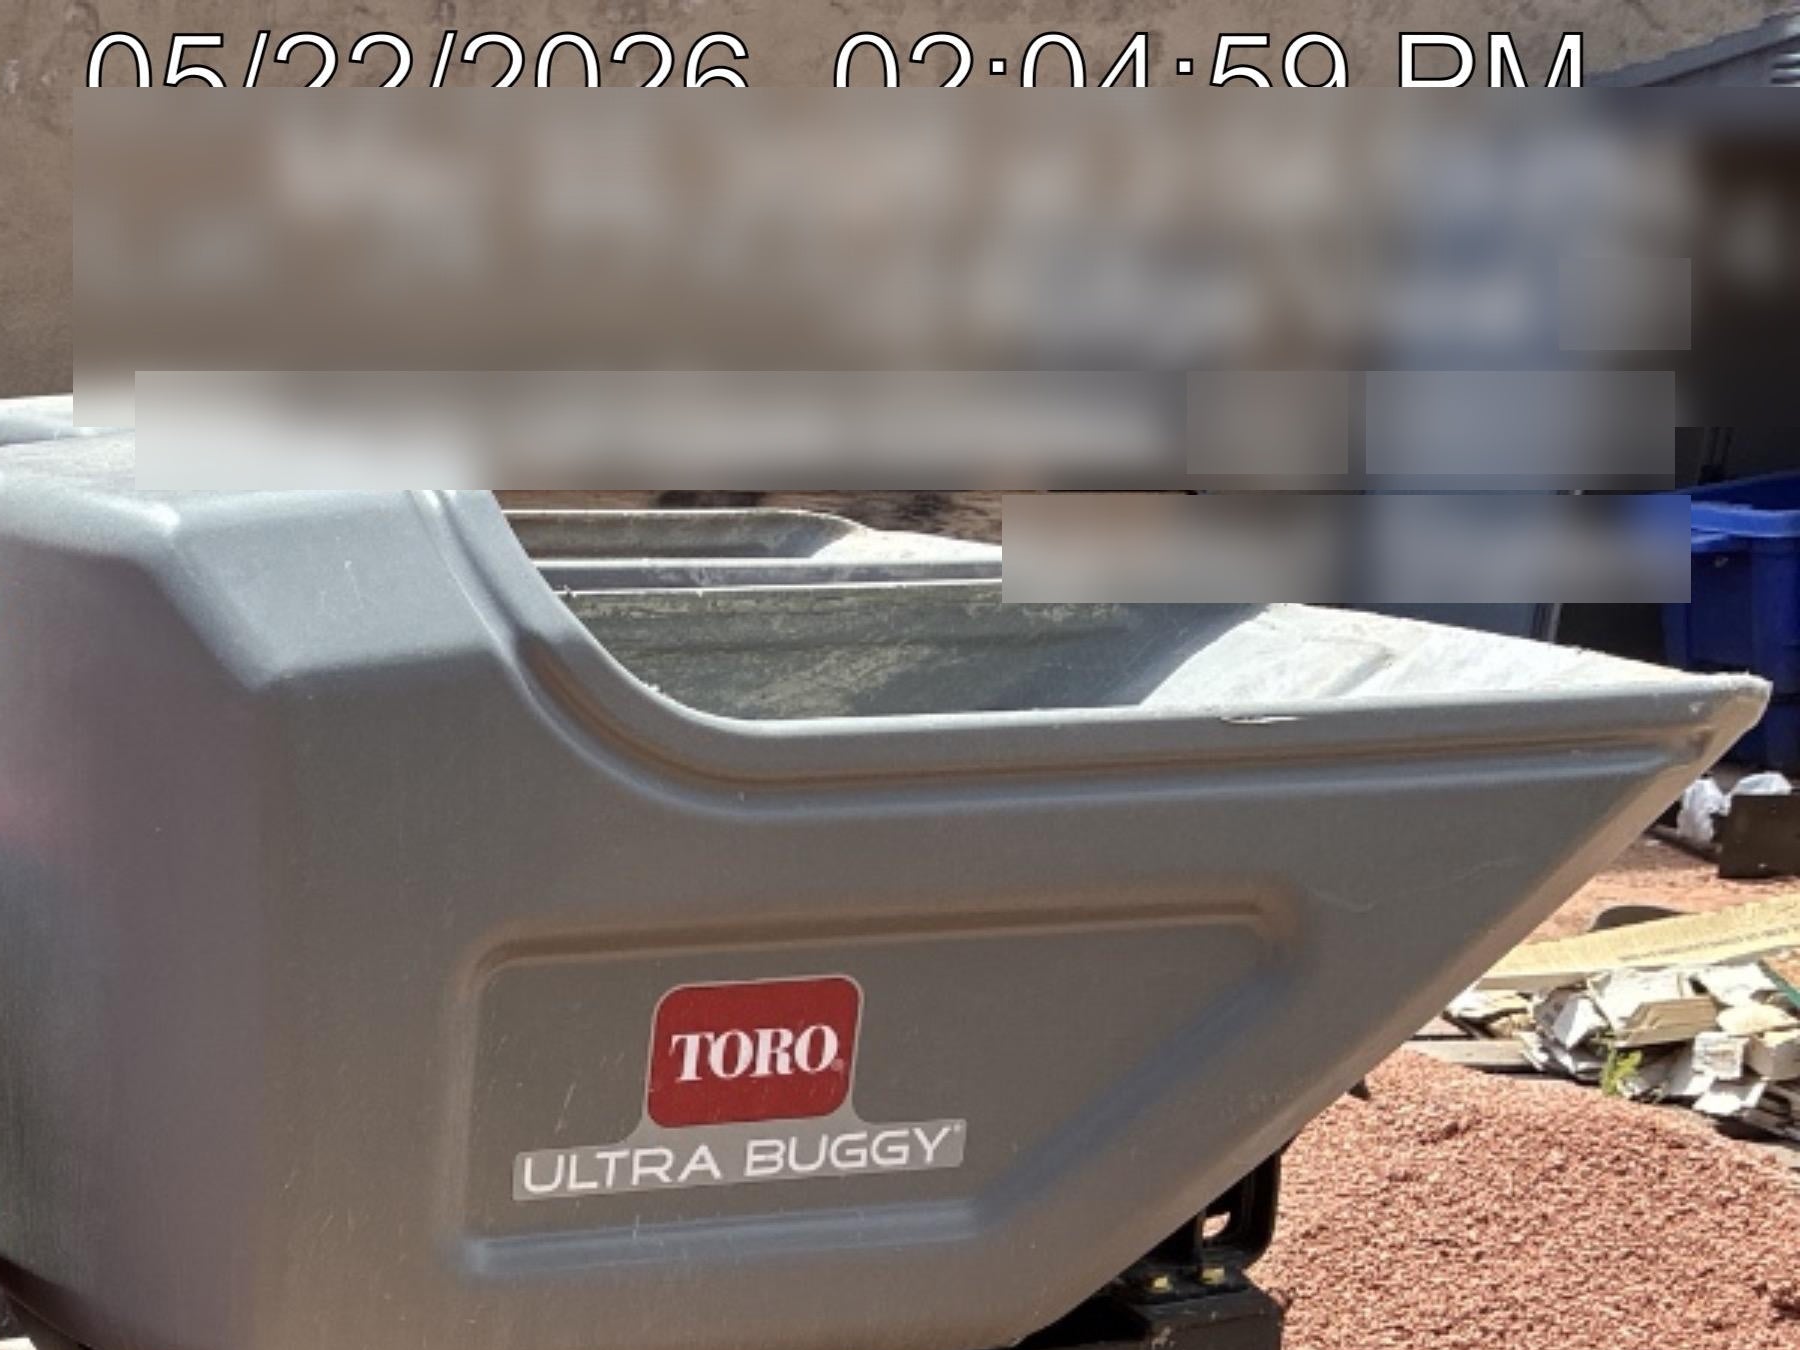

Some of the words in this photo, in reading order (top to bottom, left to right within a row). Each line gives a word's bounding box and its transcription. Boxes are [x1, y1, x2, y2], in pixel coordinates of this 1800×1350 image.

[669, 1024, 840, 1083] TORO
[523, 1144, 722, 1194] ULTRA
[743, 1126, 950, 1178] BUGGY
